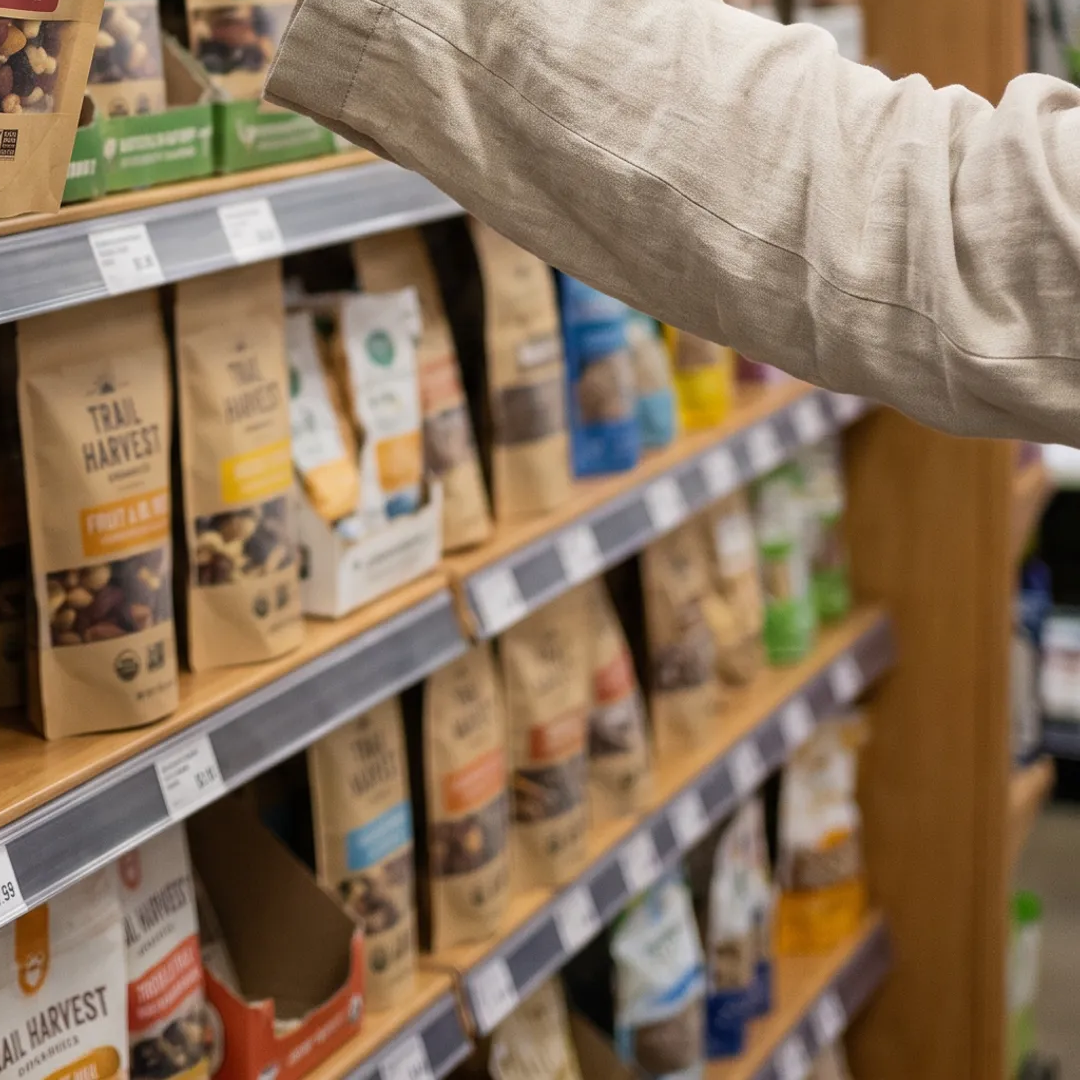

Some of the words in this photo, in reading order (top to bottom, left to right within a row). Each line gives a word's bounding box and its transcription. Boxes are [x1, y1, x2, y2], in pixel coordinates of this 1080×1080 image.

[87, 396, 141, 434] TRAIL
[82, 424, 161, 474] HARVEST
[26, 985, 110, 1052] HARVEST
